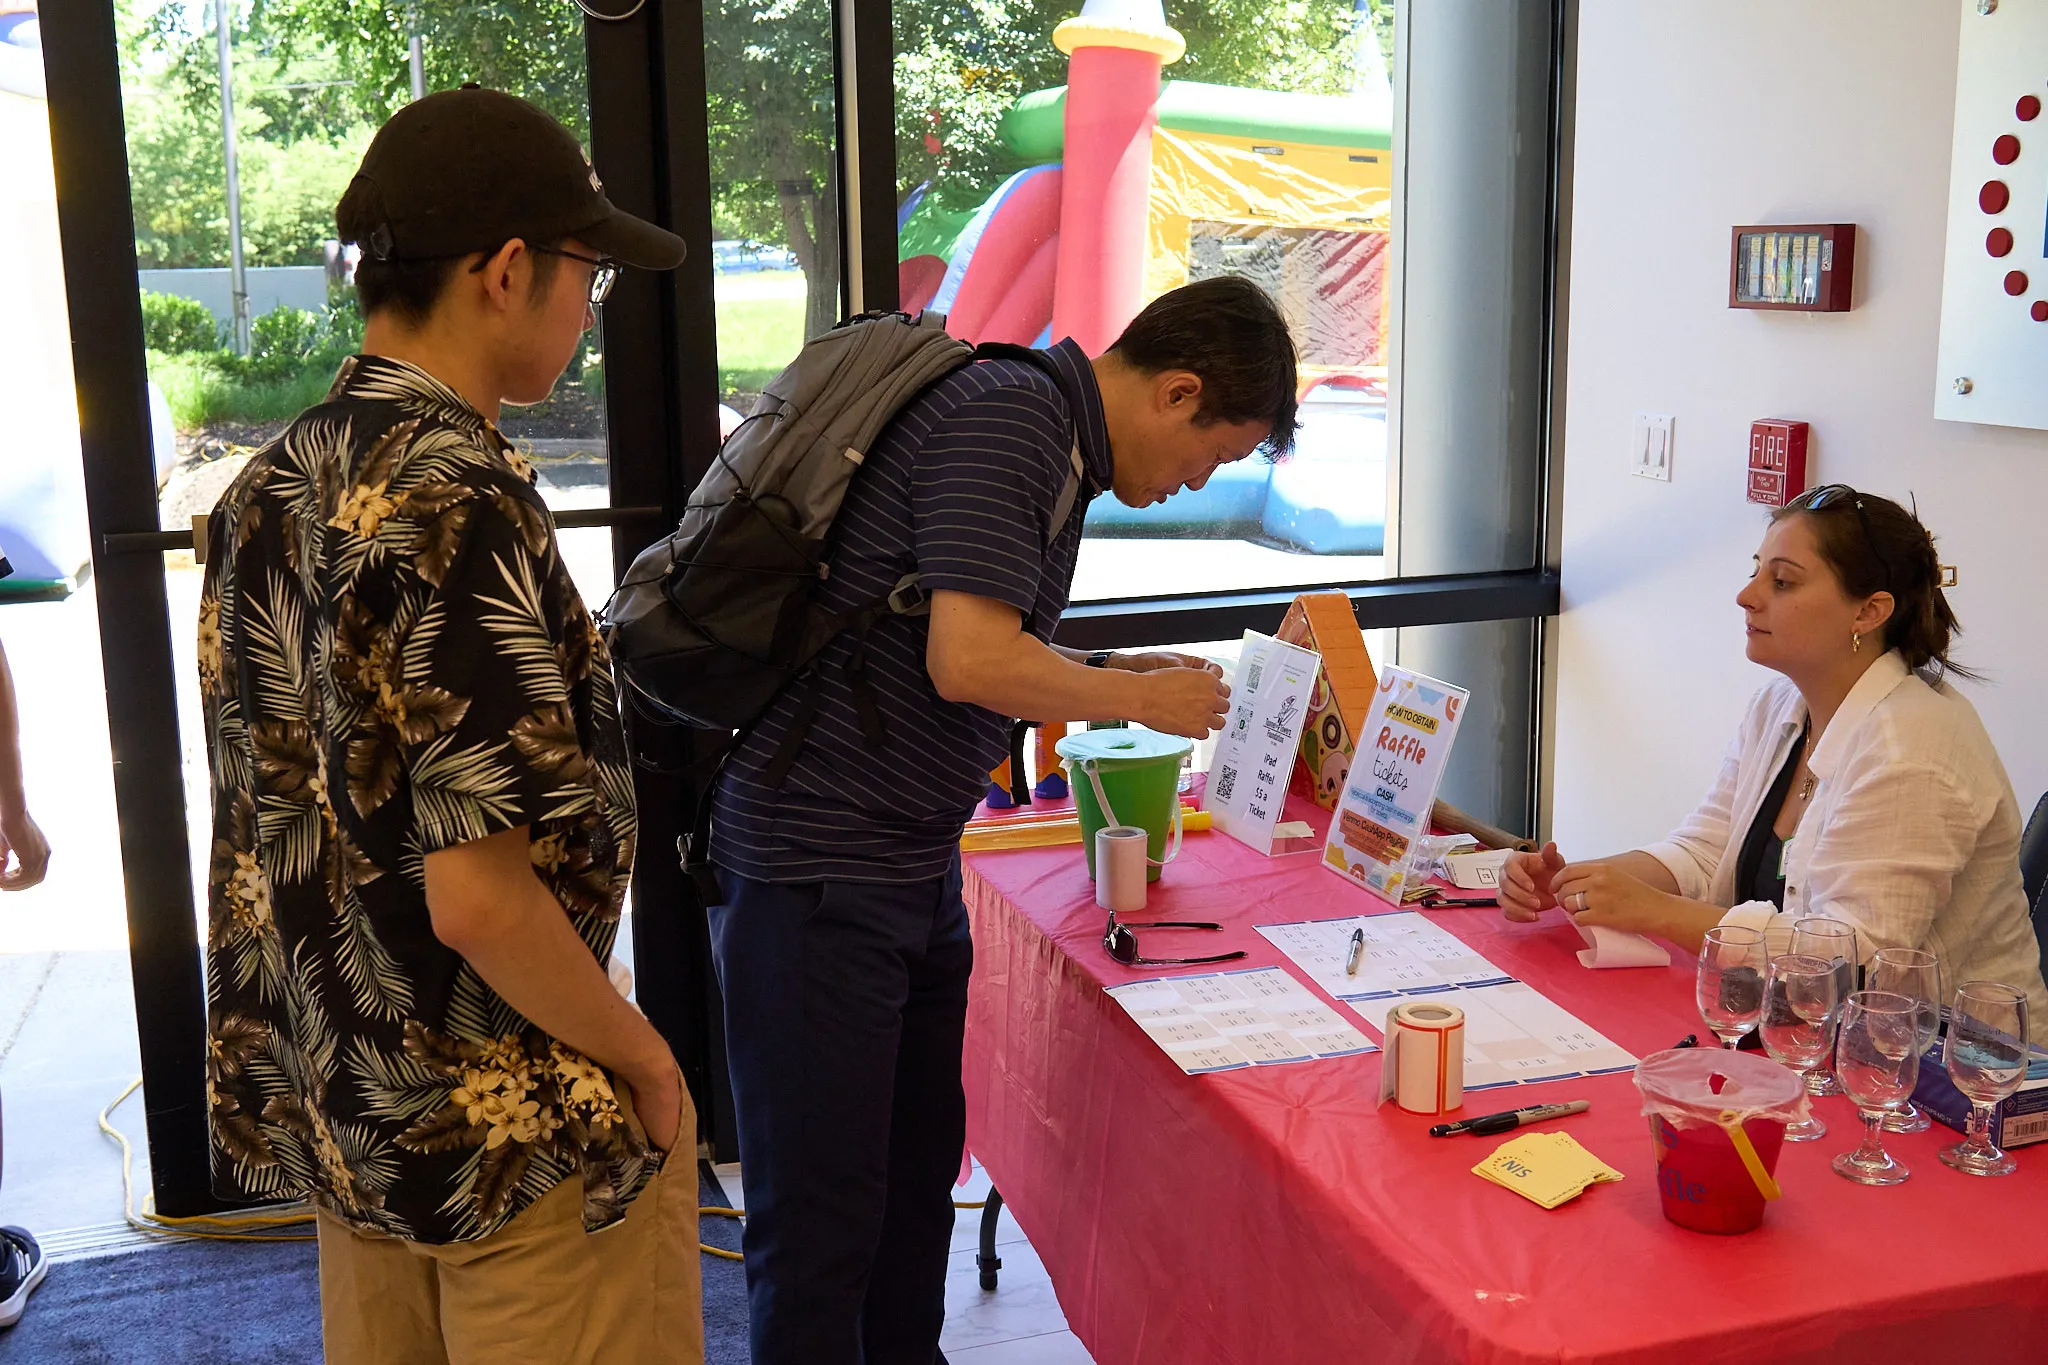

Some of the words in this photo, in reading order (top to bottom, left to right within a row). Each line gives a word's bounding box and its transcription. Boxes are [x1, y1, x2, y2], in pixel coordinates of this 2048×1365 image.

[1752, 434, 1784, 466] FIRE
[1386, 704, 1404, 718] HOW
[1403, 710, 1413, 721] TO
[1412, 714, 1437, 730] OBTAIN
[1376, 726, 1426, 765] Raffle
[1264, 754, 1277, 767] iPad
[1373, 754, 1408, 791] tickets
[1254, 787, 1263, 799] $5
[1262, 793, 1268, 802] a
[1376, 787, 1395, 802] CASH
[1249, 803, 1266, 820] Ticket
[1343, 811, 1361, 827] Venmo
[1361, 820, 1386, 841] CashApp
[1385, 832, 1407, 850] PayPal
[1500, 1160, 1533, 1178] NIS
